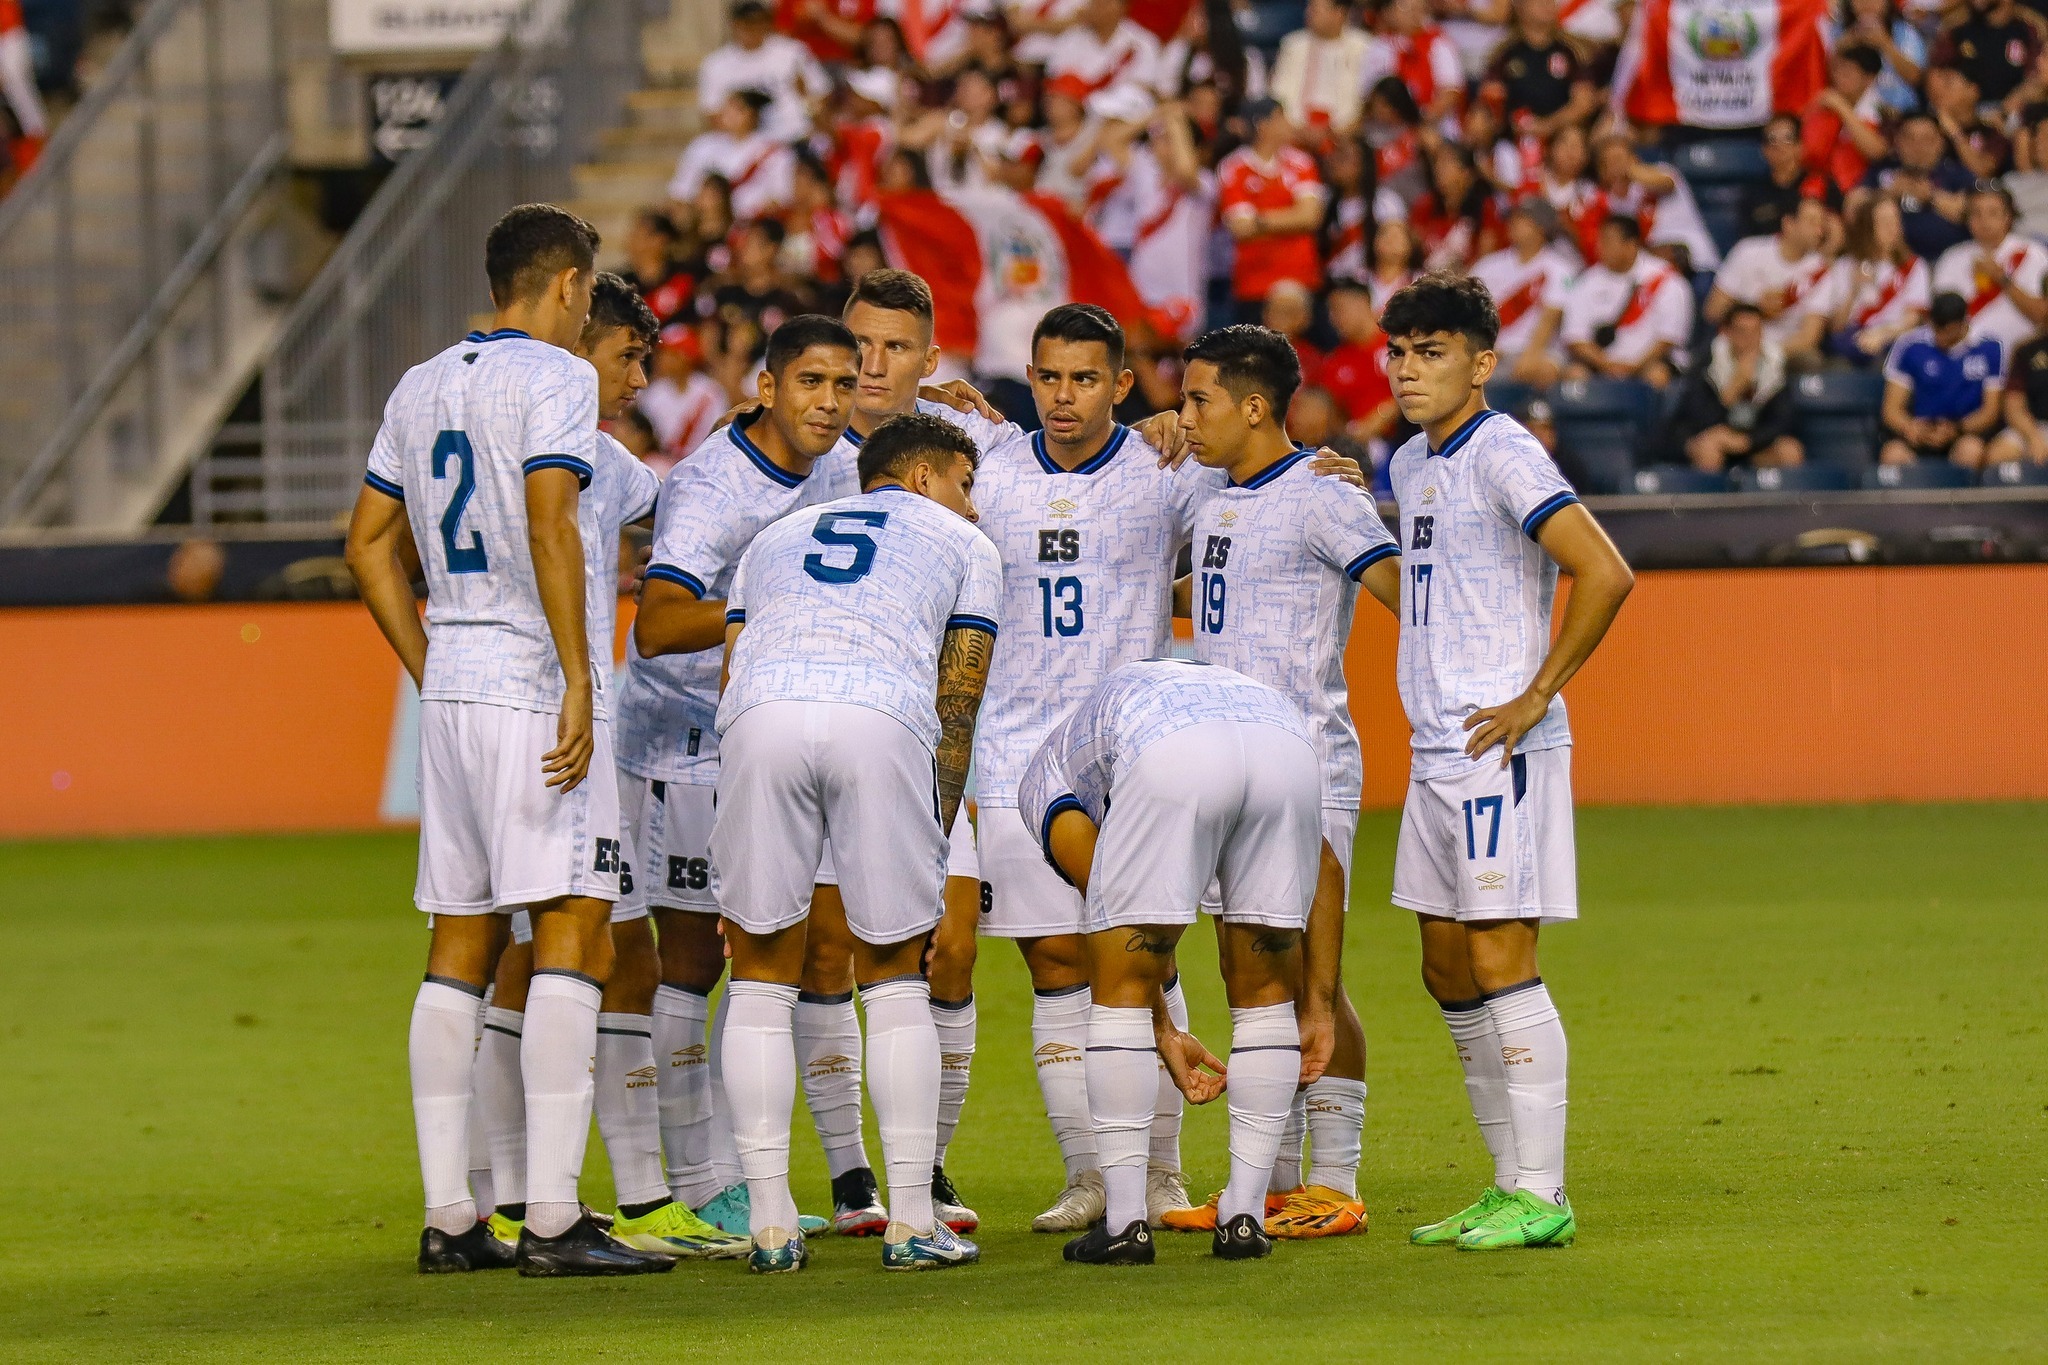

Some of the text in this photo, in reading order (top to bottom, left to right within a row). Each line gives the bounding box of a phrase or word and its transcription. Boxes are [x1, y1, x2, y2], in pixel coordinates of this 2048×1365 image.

[431, 430, 488, 573] 2
[803, 511, 889, 585] 5
[1038, 529, 1079, 562] ES
[1411, 516, 1434, 550] ES
[1202, 535, 1231, 569] ES
[1038, 576, 1084, 638] 13
[1201, 572, 1227, 634] 19
[1411, 564, 1433, 627] 17
[1462, 795, 1504, 860] 17
[593, 837, 620, 874] ES
[667, 855, 708, 890] ES
[1478, 883, 1504, 891] umbro
[1037, 1055, 1083, 1067] umbro
